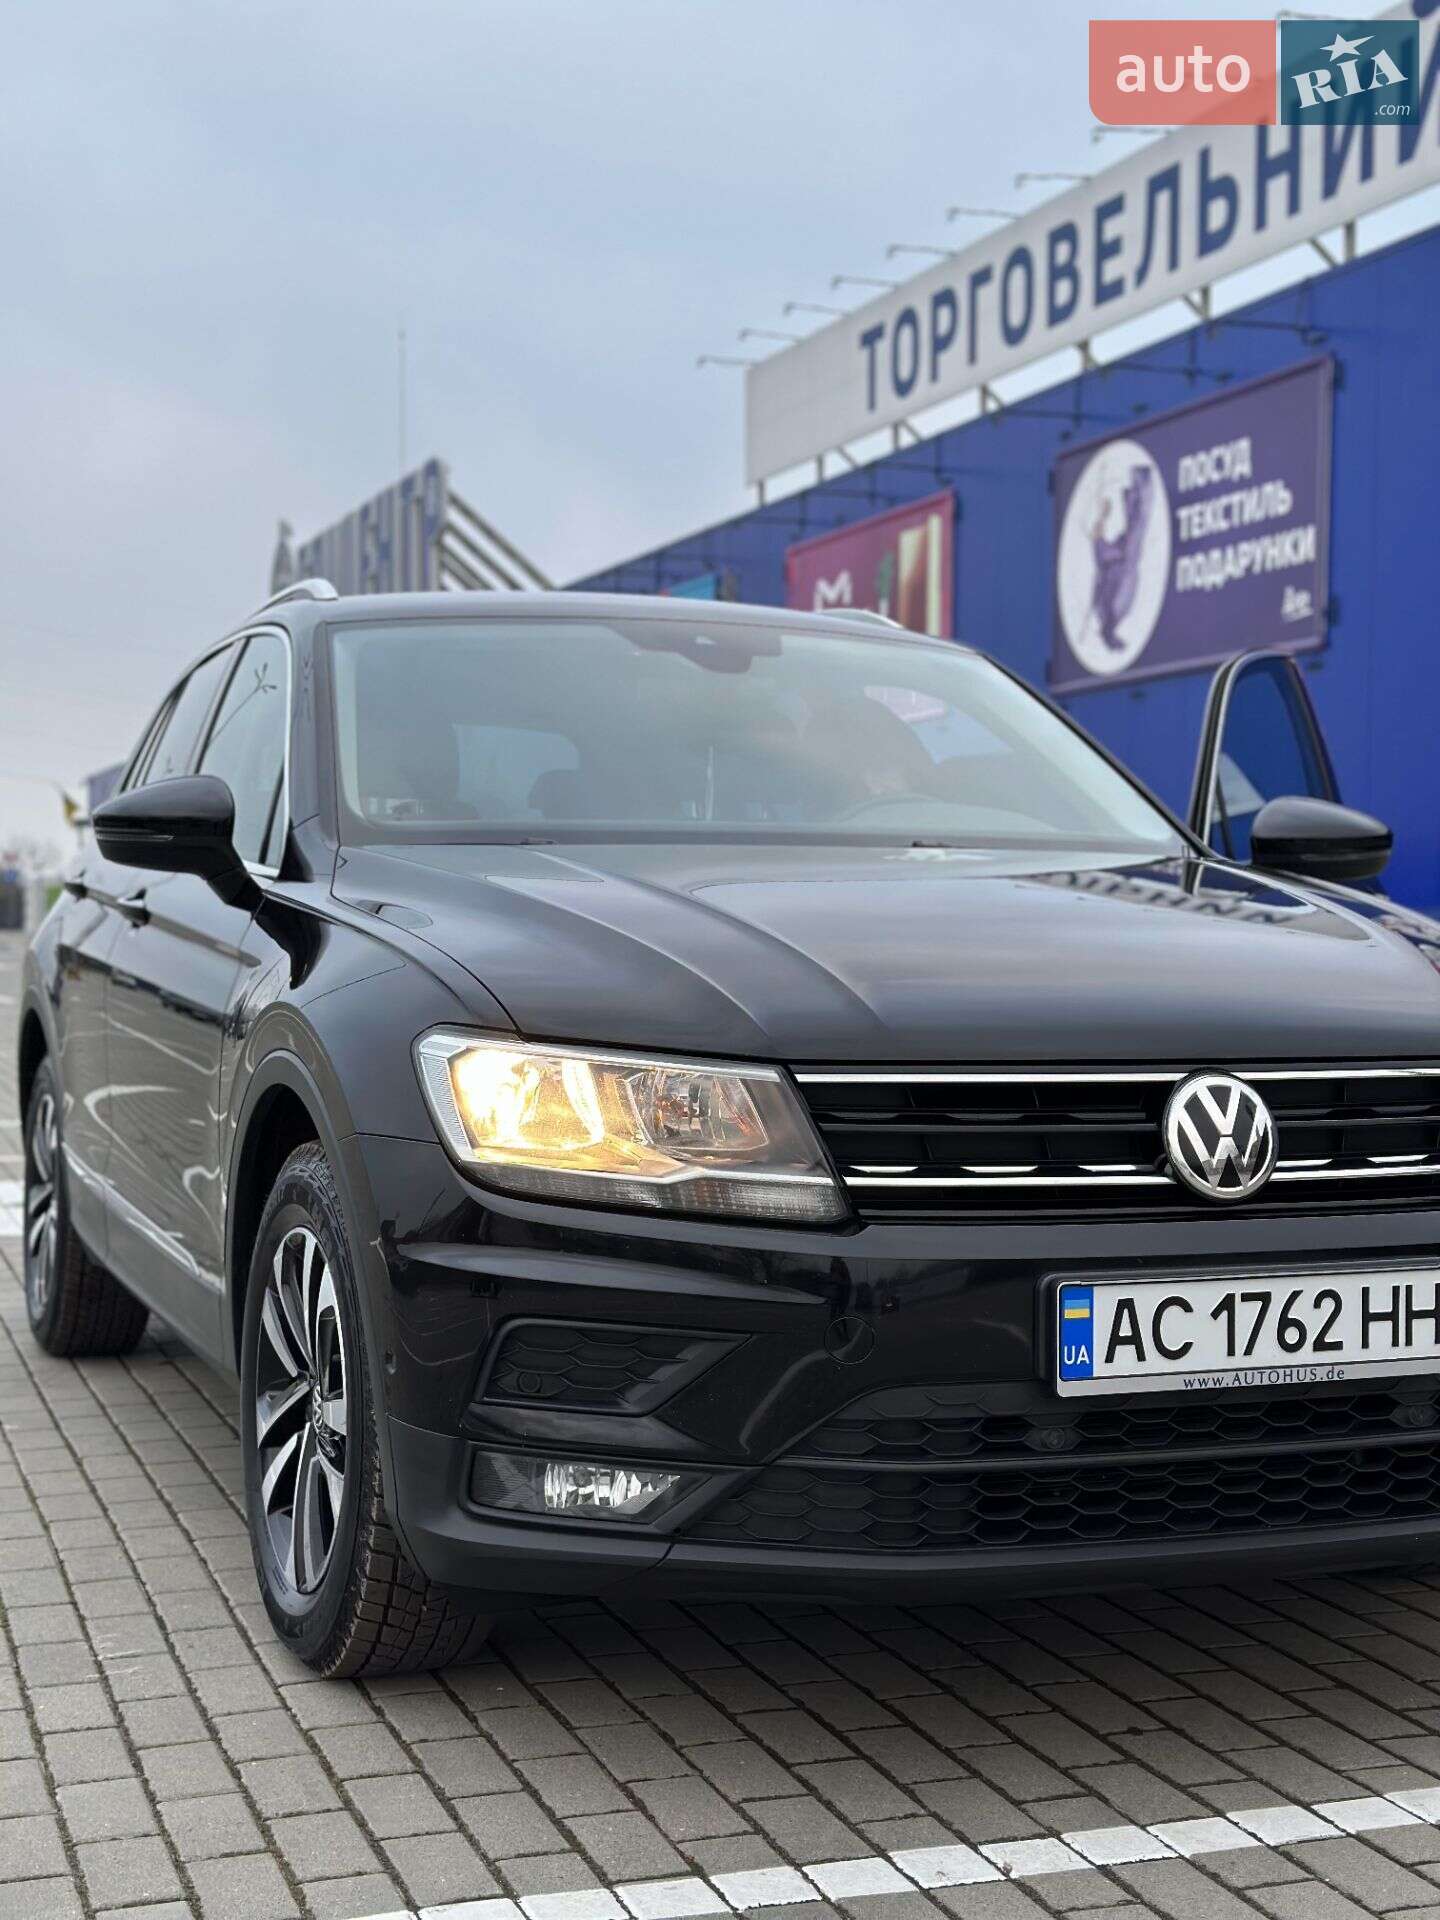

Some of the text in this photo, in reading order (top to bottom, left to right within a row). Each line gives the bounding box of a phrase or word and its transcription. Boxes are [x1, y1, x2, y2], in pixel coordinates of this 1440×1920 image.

[1178, 436, 1253, 493] ПОСУД
[1176, 479, 1293, 541] ТЕКСТИЛЬ
[1175, 524, 1317, 592] ПОДАРУНКИ
[1064, 1345, 1090, 1365] UA
[1104, 1295, 1194, 1364] AC
[1210, 1289, 1343, 1357] 1762
[1183, 1366, 1345, 1389] www.AUTOHUS.de
